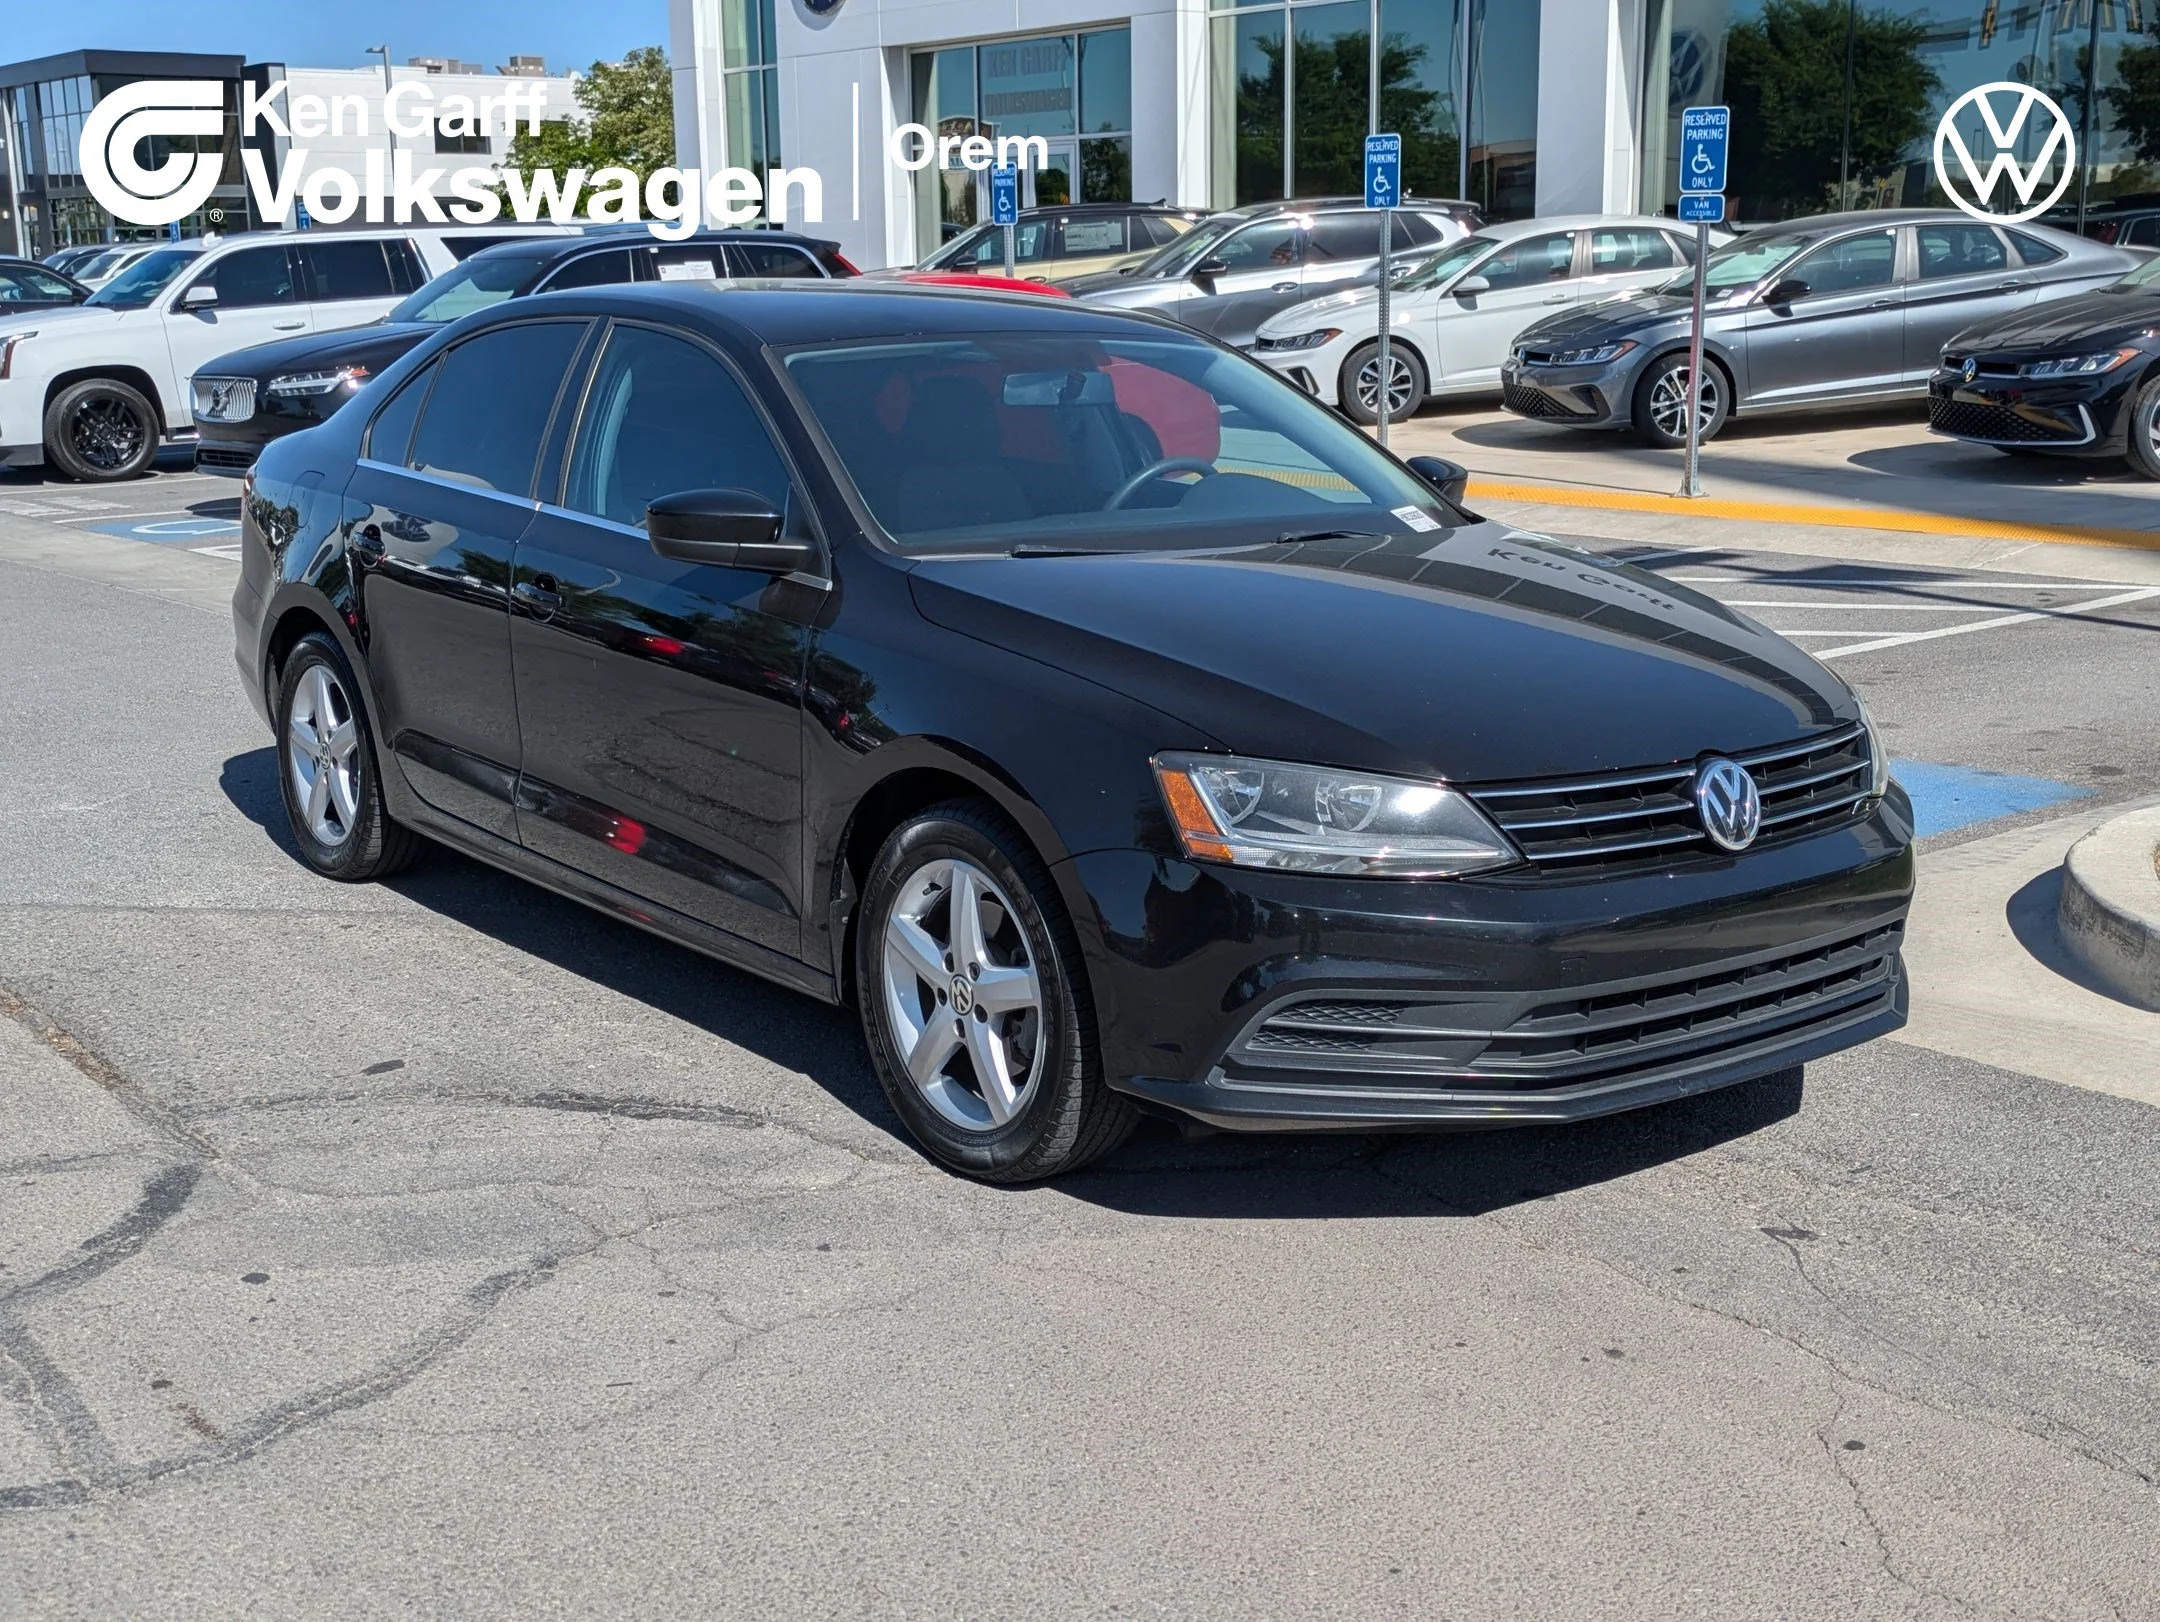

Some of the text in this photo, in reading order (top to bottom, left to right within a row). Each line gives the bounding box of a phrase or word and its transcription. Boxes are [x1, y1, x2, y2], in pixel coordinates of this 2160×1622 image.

[1685, 114, 1726, 126] RESERVED
[1687, 128, 1723, 140] PARKING
[1367, 141, 1398, 151] RESERVED
[1369, 154, 1396, 164] PARKING
[1692, 177, 1713, 188] ONLY
[1374, 196, 1390, 206] ONLY
[1694, 200, 1710, 209] VAN
